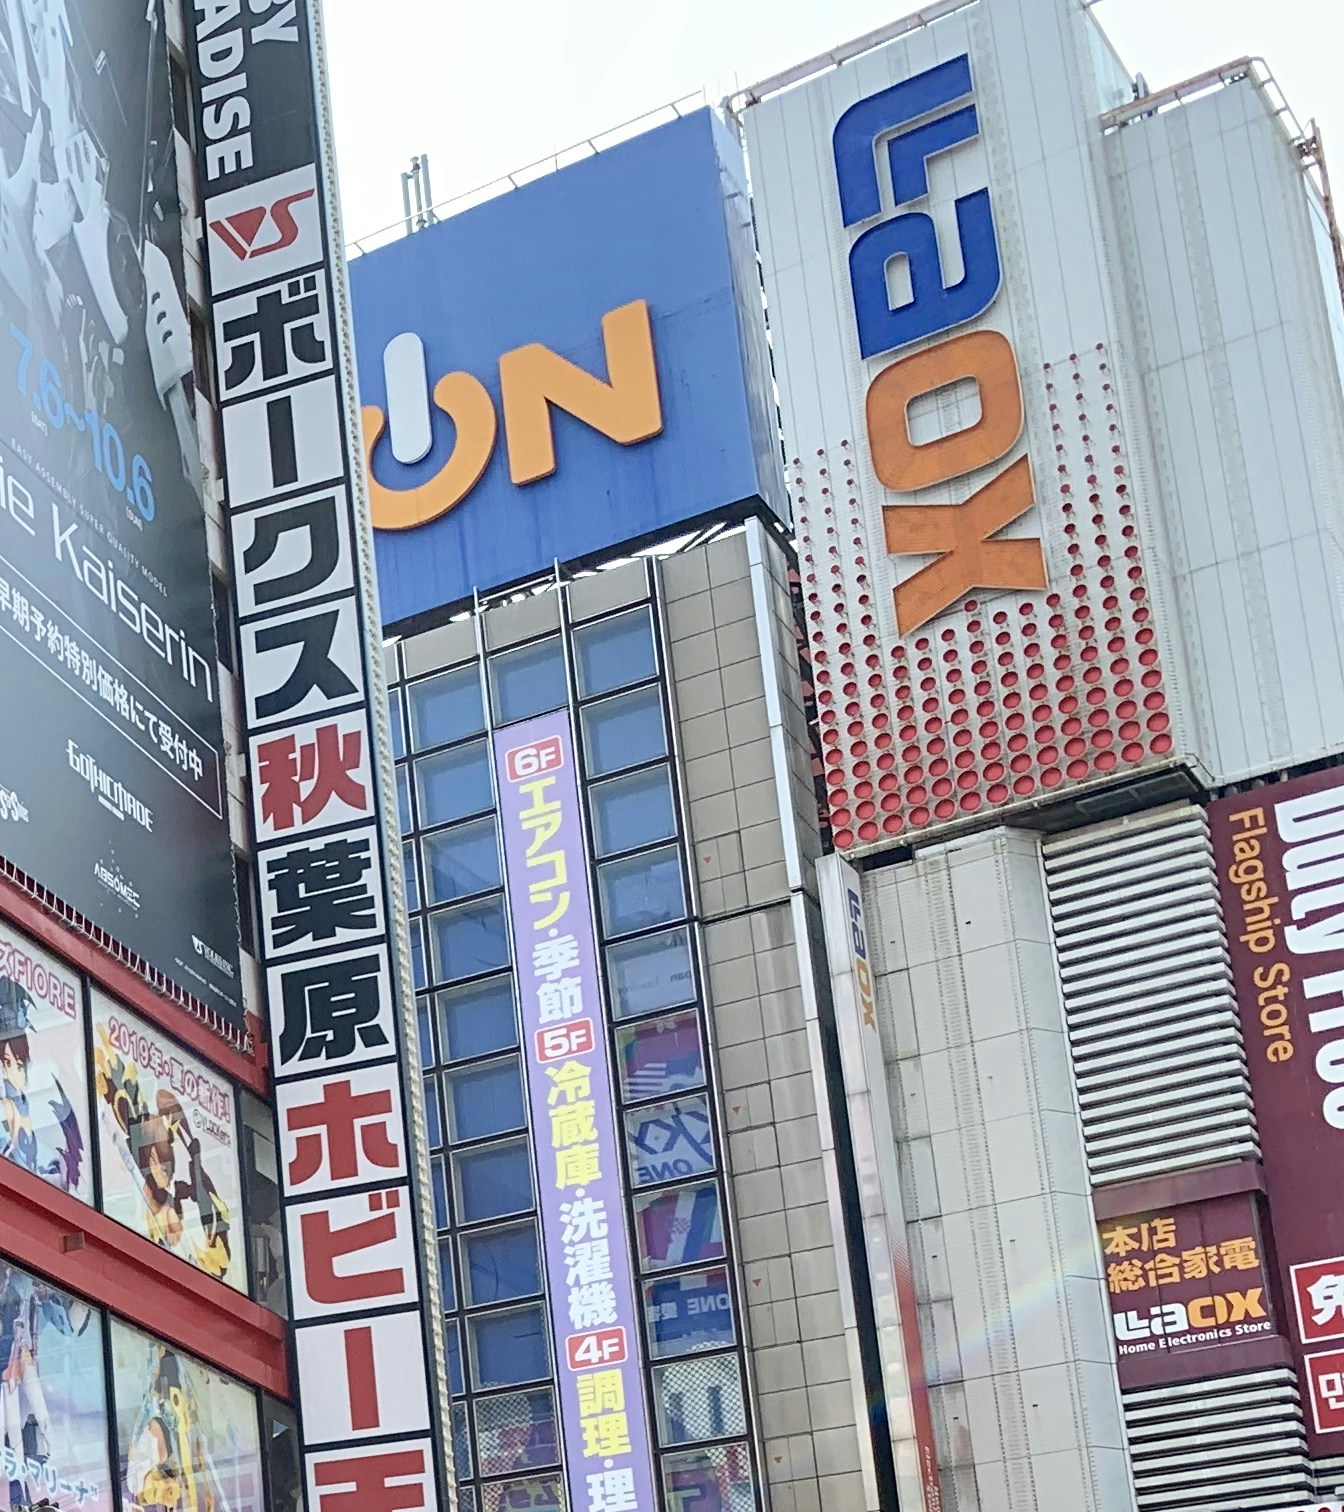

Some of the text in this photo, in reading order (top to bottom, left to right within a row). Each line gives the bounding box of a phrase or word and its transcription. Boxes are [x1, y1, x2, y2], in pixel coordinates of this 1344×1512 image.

[52, 502, 214, 703] Kaiserin
[513, 745, 558, 774] 6F
[1228, 805, 1295, 1064] Flagship Store
[543, 1027, 589, 1057] 5F
[1102, 1217, 1177, 1257] 本店
[1107, 1237, 1261, 1294] 総合家電
[573, 1333, 620, 1364] 4F
[1118, 1319, 1272, 1357] Home Electronics Store
